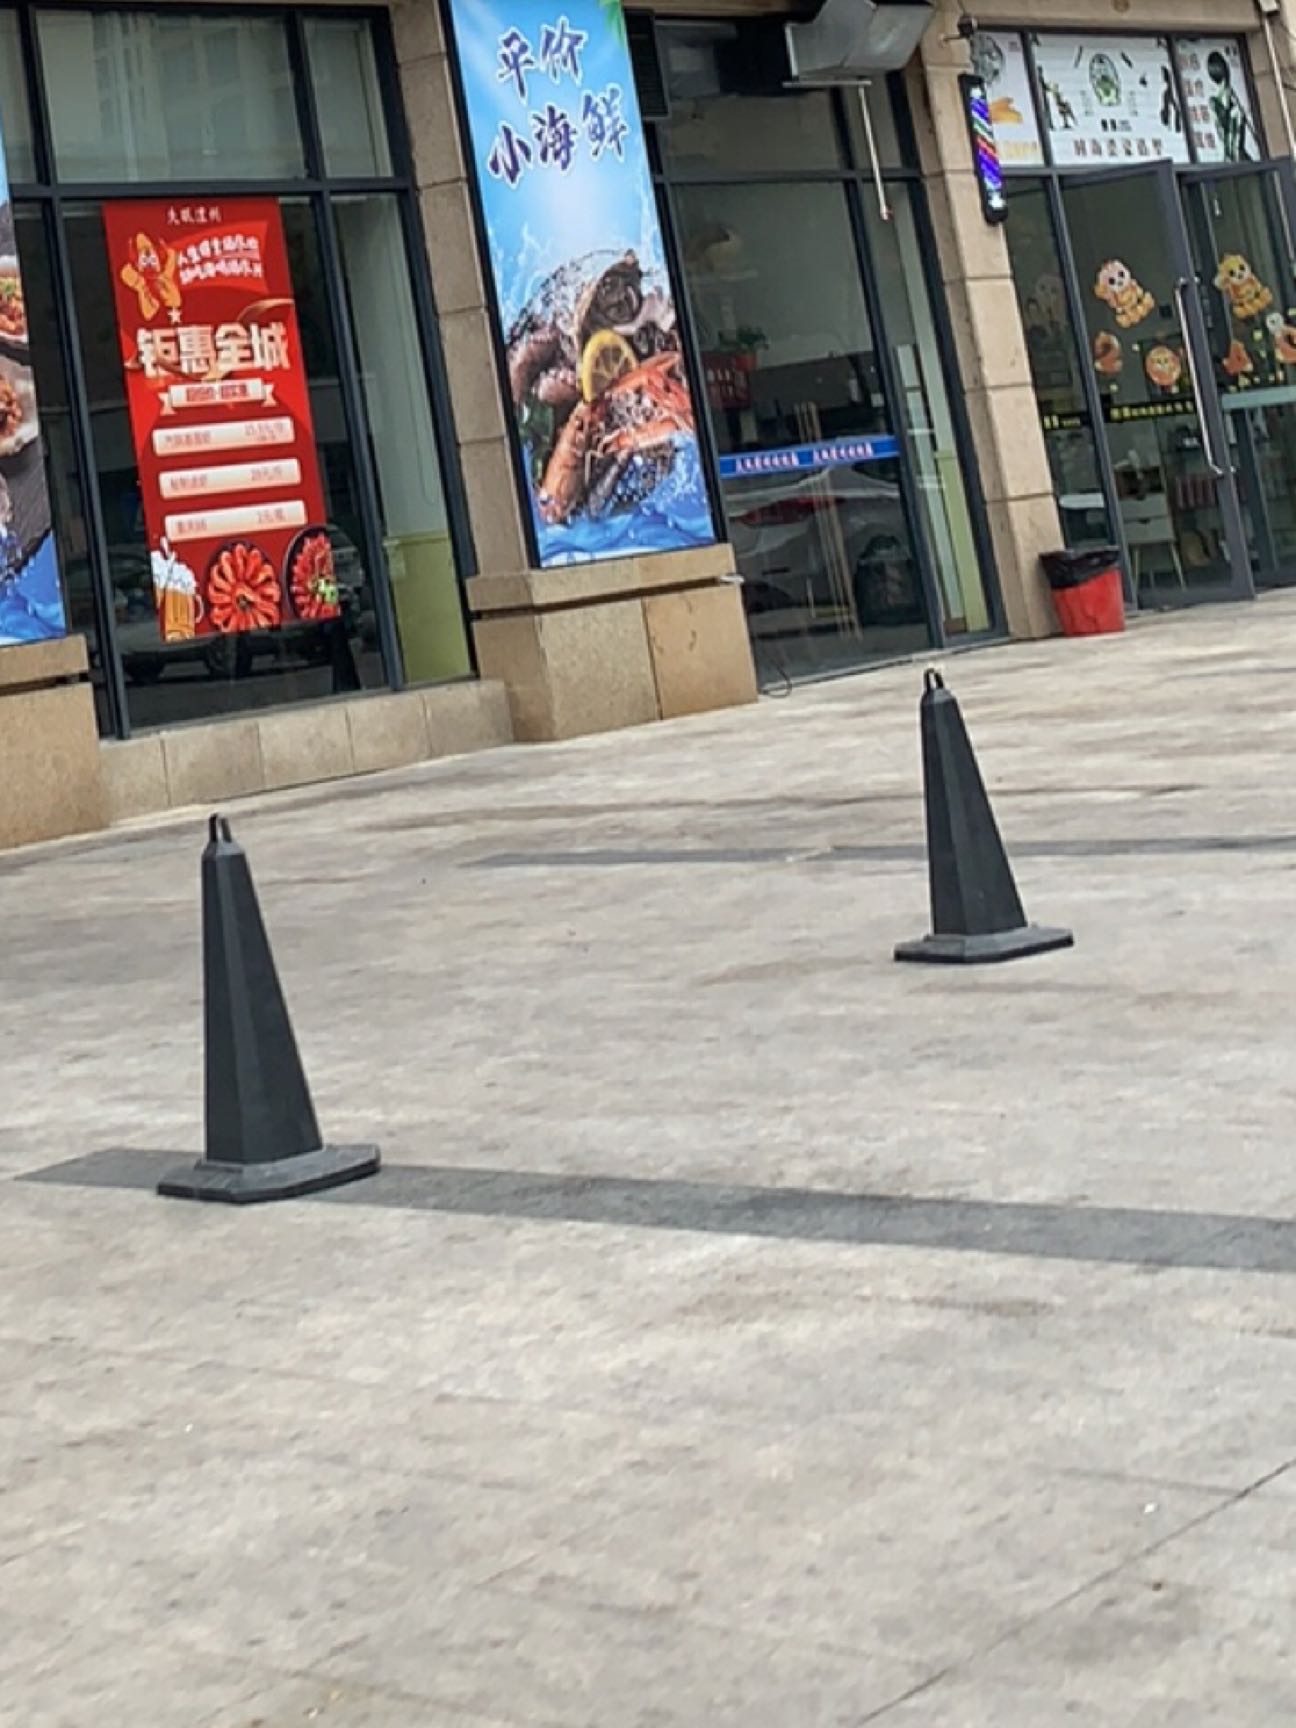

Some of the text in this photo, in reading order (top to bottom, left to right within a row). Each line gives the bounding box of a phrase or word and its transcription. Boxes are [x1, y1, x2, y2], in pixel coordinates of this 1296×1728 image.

[498, 17, 585, 100] 平价
[488, 85, 628, 185] 小海鲜
[136, 321, 290, 379] 钜惠全城
